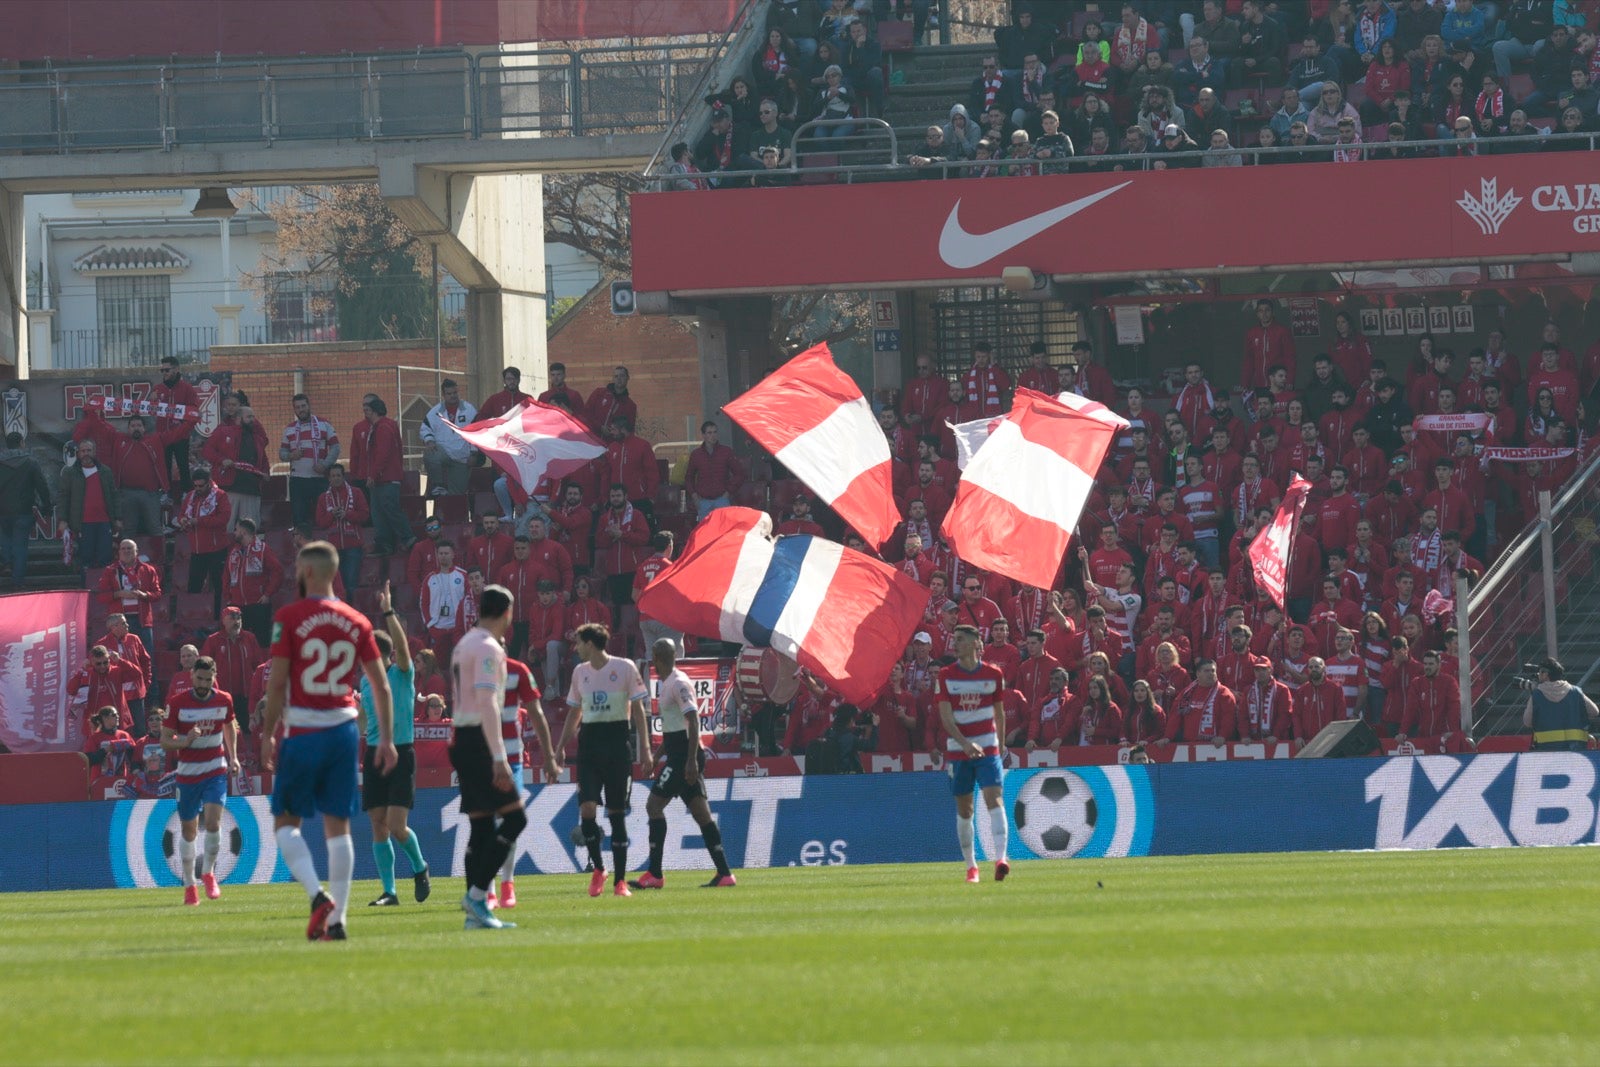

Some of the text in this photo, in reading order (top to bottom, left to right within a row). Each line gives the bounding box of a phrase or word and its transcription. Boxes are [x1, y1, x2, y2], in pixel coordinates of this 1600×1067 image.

[1531, 184, 1600, 212] CAJA
[302, 638, 356, 696] 22
[1364, 752, 1600, 850] 1XB
